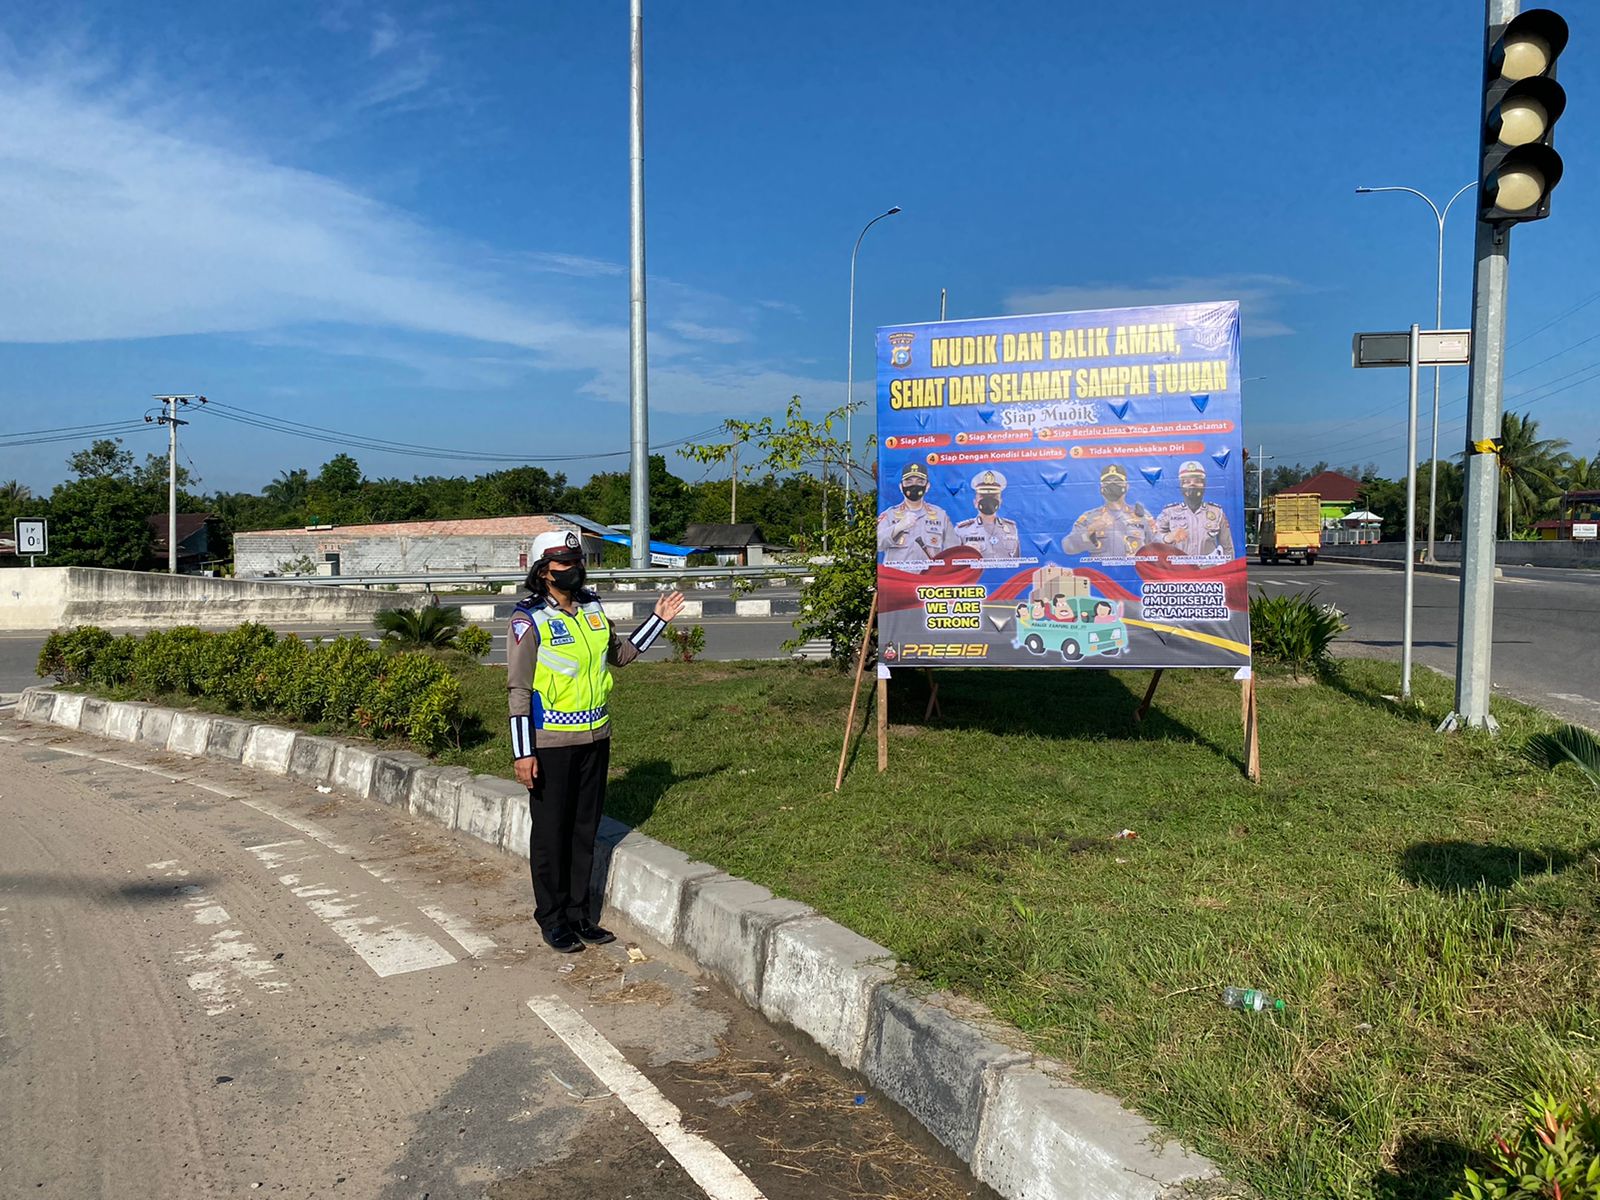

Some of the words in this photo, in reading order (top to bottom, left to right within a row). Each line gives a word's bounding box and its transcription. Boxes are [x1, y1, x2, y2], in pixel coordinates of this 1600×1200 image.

[931, 336, 998, 368] MUDIK
[1003, 331, 1043, 364] DAN
[1049, 327, 1110, 360] BALIK
[1115, 322, 1181, 356] AMAN,
[890, 375, 946, 410] SEHAT
[948, 374, 987, 406] DAN
[989, 368, 1072, 404] SELAMAT
[1075, 364, 1150, 398] SAMPAI
[1152, 360, 1228, 394] TUJUAN
[1003, 410, 1036, 426] Siap
[1040, 405, 1095, 422] Mudik
[968, 433, 985, 442] Siap
[987, 431, 1029, 440] Kendaraan
[1053, 429, 1071, 438] Siap
[1150, 424, 1174, 432] Aman
[1175, 423, 1192, 431] dan
[1193, 422, 1227, 430] Selamat
[900, 437, 917, 445] Siap
[918, 436, 936, 444] Fisik
[1089, 447, 1112, 455] Tidak
[1113, 445, 1168, 454] Memaksakan
[1169, 443, 1185, 452] Diri
[940, 454, 957, 463] Siap
[958, 453, 989, 462] Dengan
[990, 451, 1020, 460] Kondisi
[1021, 450, 1037, 458] Lalu
[1039, 449, 1063, 457] Lintas
[918, 586, 986, 599] TOGETHER
[1143, 583, 1223, 594] #MUDIKAMAN
[1143, 595, 1223, 606] #MUDIKSEHAT
[926, 601, 948, 614] WE
[953, 601, 981, 614] ARE
[1143, 607, 1229, 618] #SALAMPRESISI
[927, 616, 980, 629] STRONG
[901, 643, 990, 657] PRESISI
